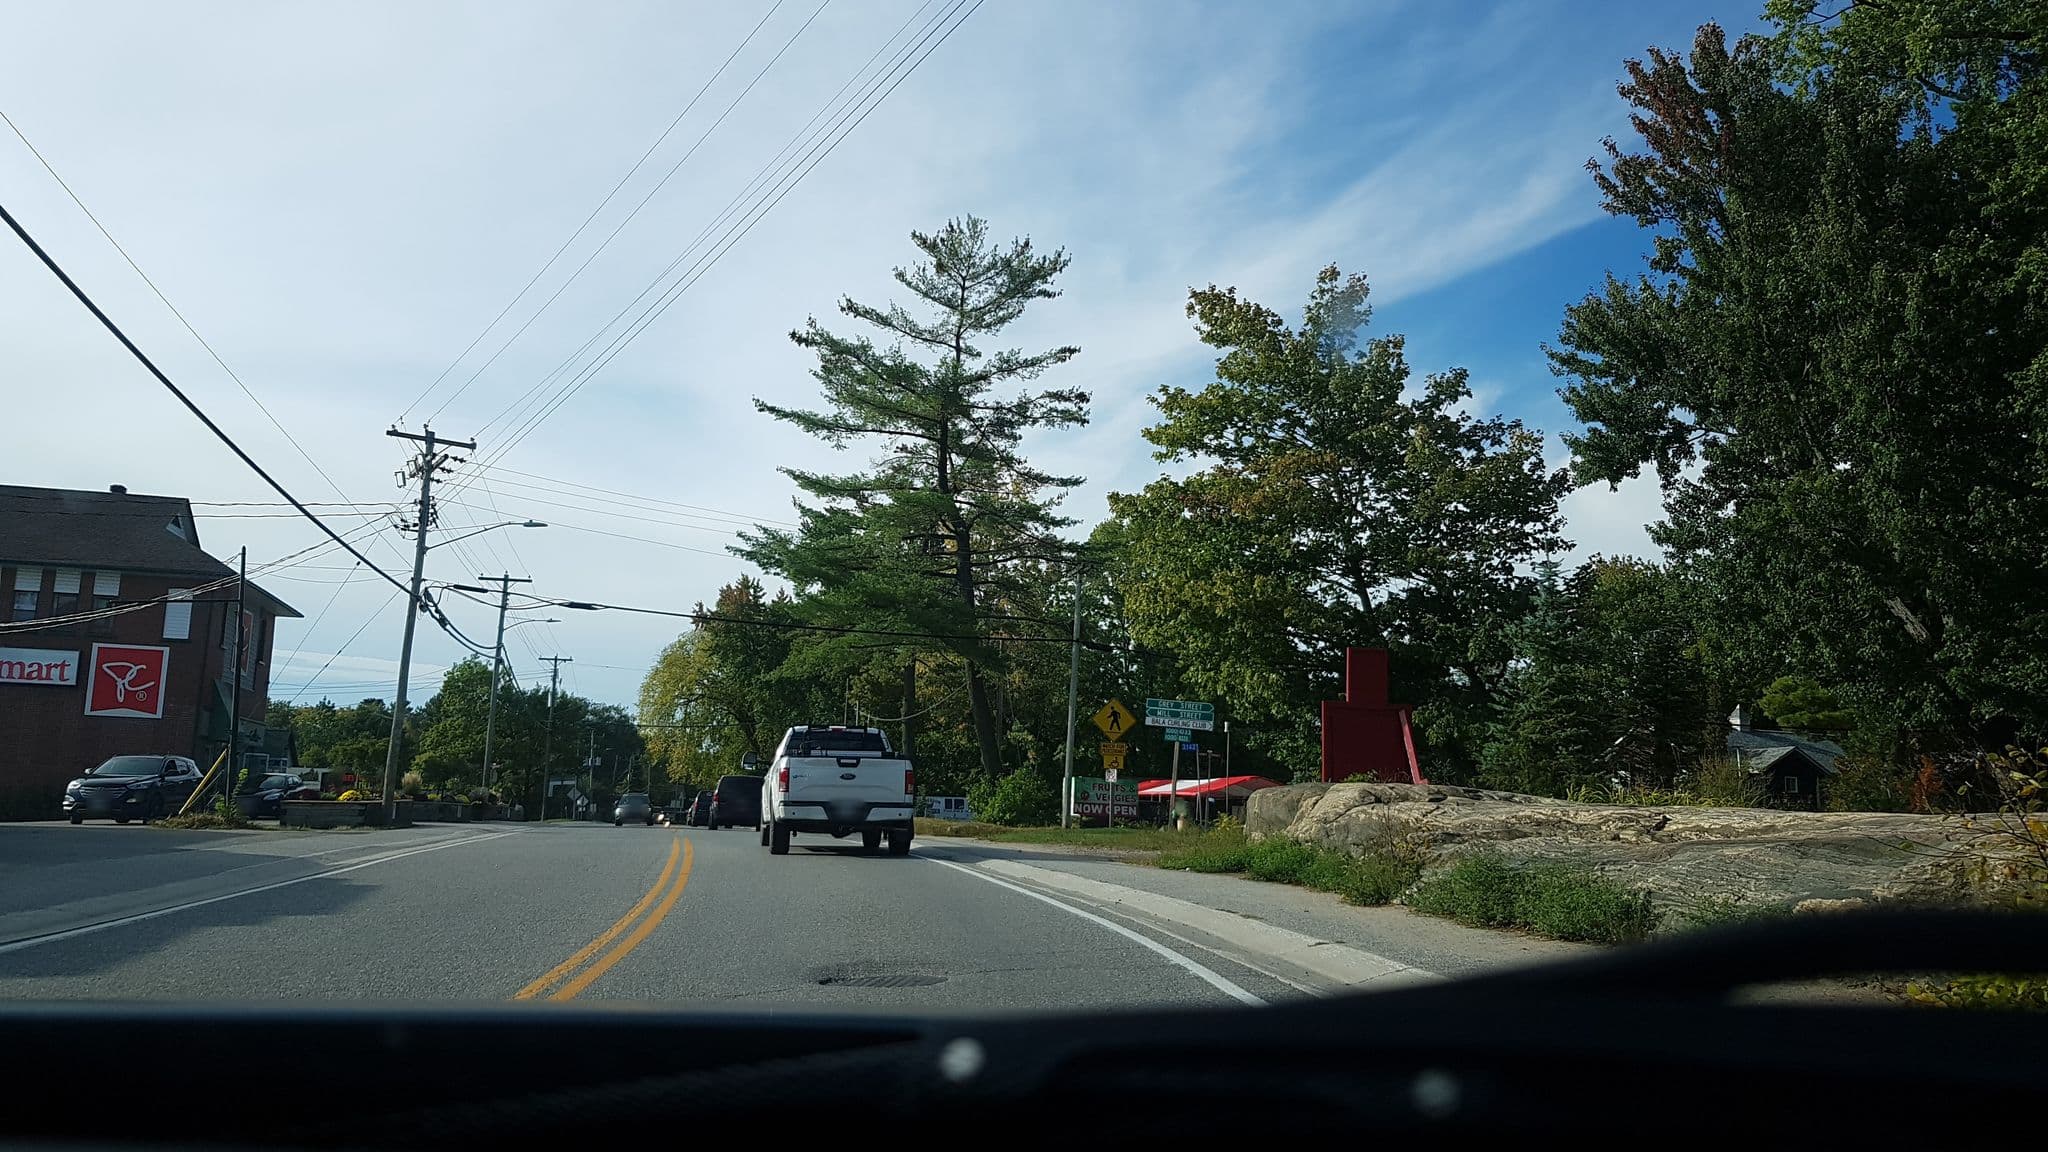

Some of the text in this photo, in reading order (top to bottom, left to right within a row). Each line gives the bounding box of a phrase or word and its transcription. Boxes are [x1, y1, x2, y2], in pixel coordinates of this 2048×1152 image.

[1180, 702, 1203, 710] STREET
[1180, 711, 1201, 720] STREET
[1191, 721, 1207, 729] CLUB
[1092, 783, 1126, 793] FRUTS
[1074, 803, 1103, 814] NOW
